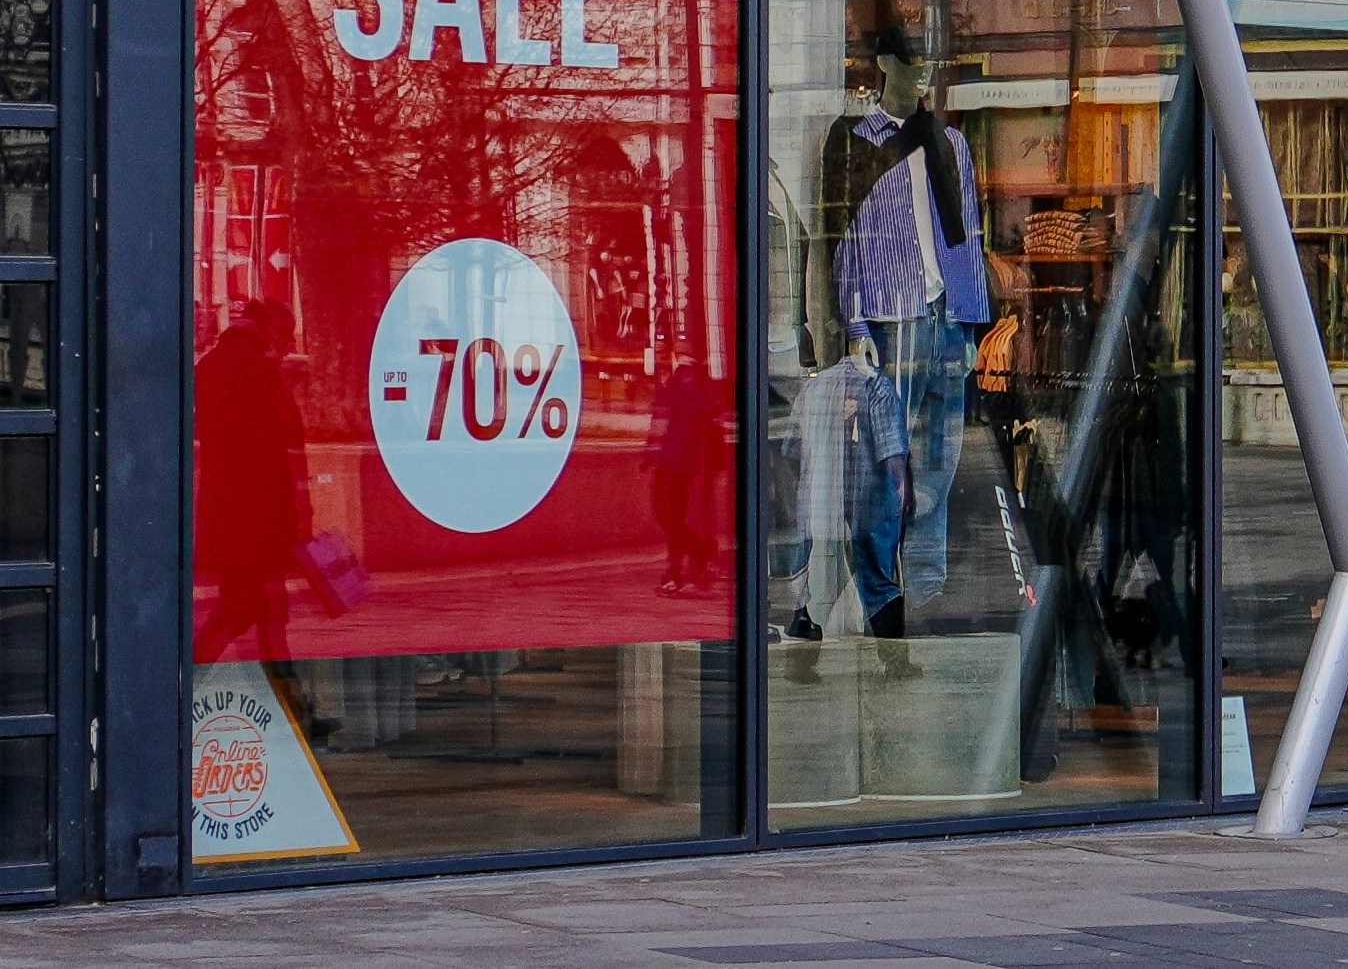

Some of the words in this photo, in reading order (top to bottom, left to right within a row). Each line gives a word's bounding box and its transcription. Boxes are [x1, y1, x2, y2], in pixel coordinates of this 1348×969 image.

[384, 372, 395, 383] UP
[397, 372, 407, 383] TO
[215, 691, 234, 711] UP
[240, 694, 272, 731] YOUR
[199, 813, 229, 840] THIS
[235, 802, 275, 839] STORE
